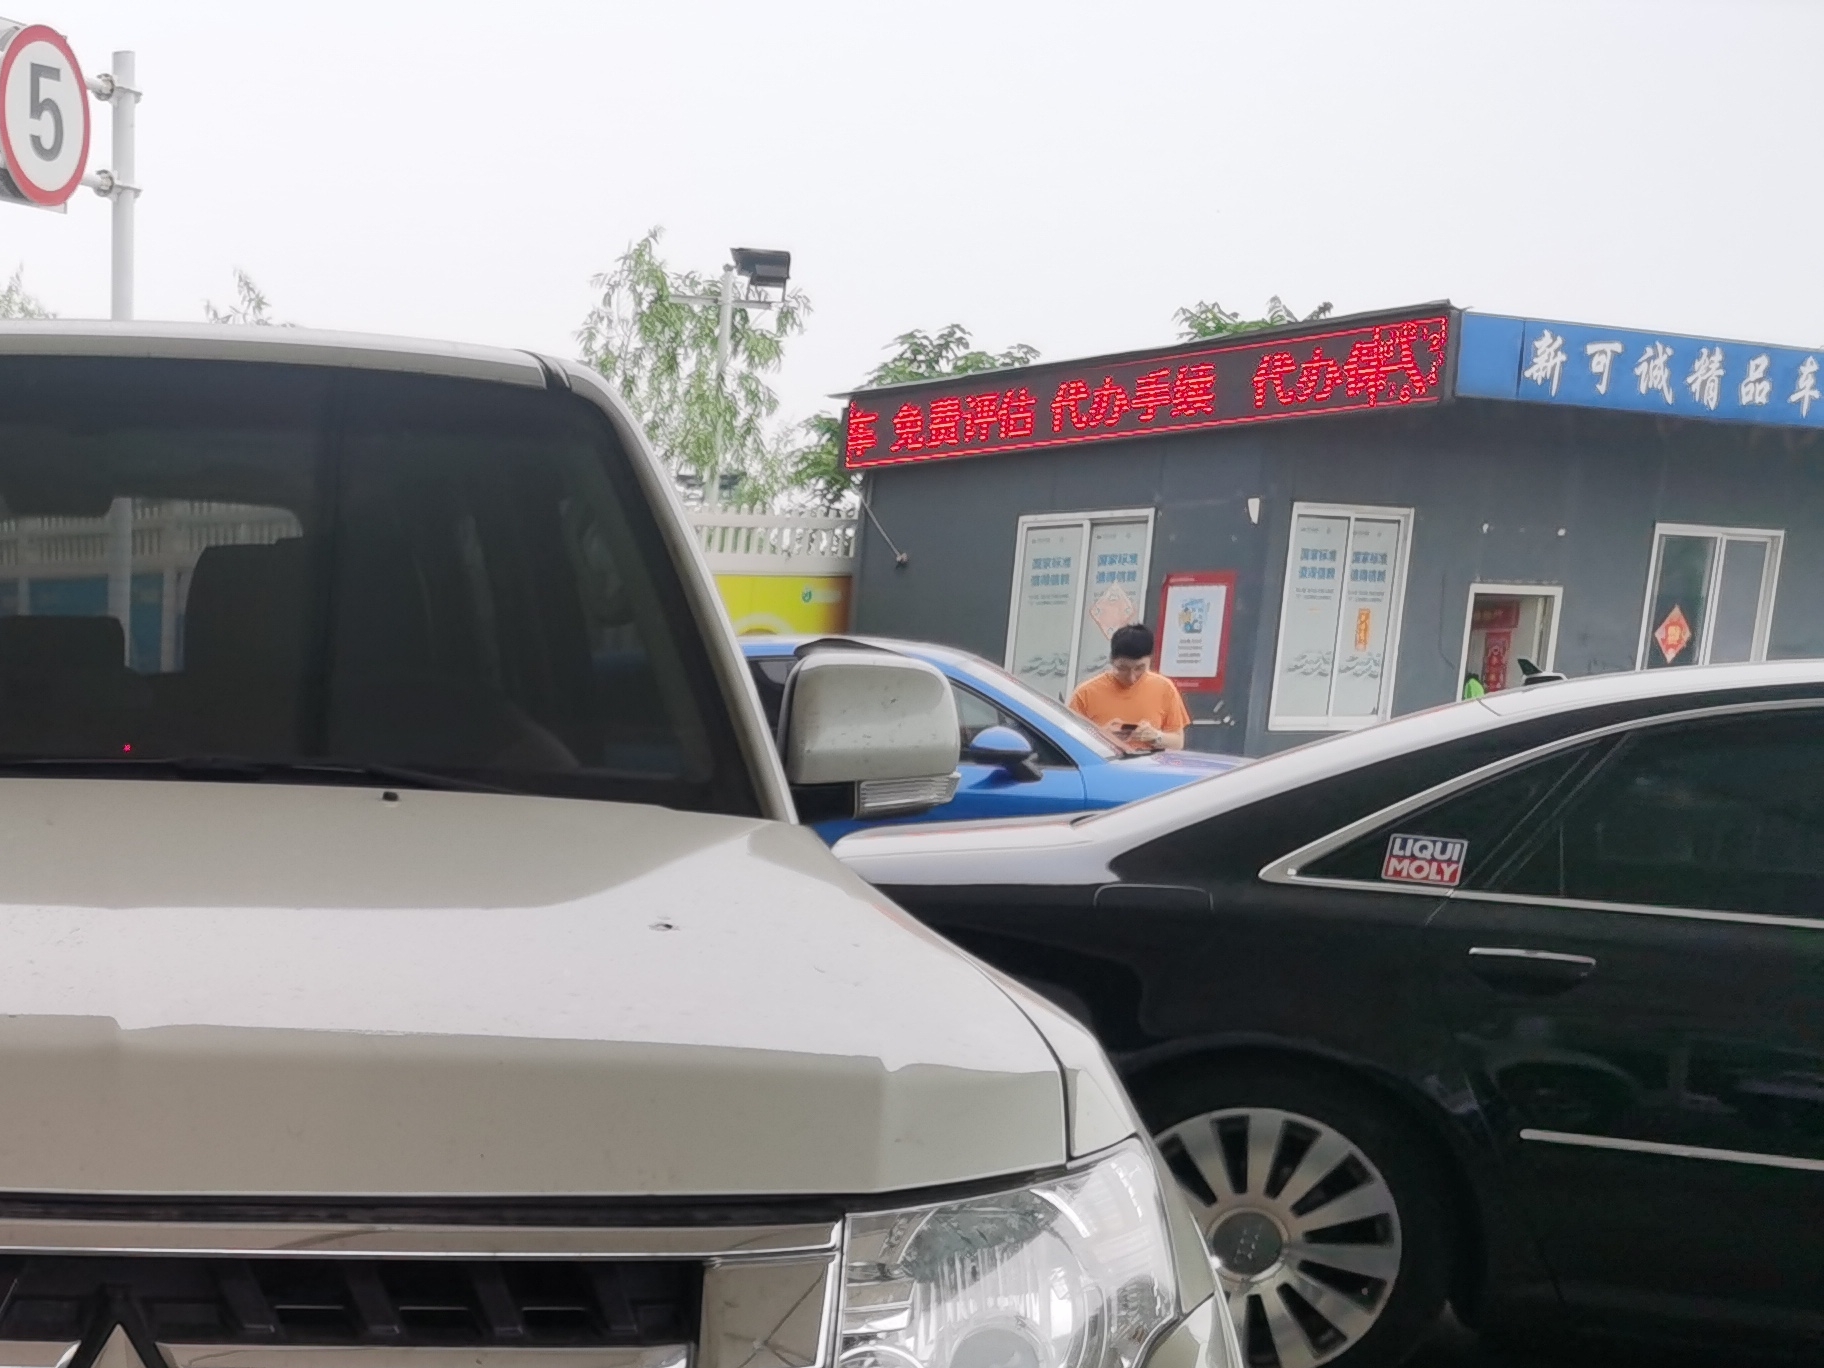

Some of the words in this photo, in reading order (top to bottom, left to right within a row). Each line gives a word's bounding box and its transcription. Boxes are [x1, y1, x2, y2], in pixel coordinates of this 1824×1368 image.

[29, 62, 64, 163] 5
[1524, 329, 1822, 418] 新可诚精品车
[889, 387, 1038, 452] 免费评估
[1387, 857, 1459, 882] MOLY
[1392, 838, 1461, 862] LIQUI
